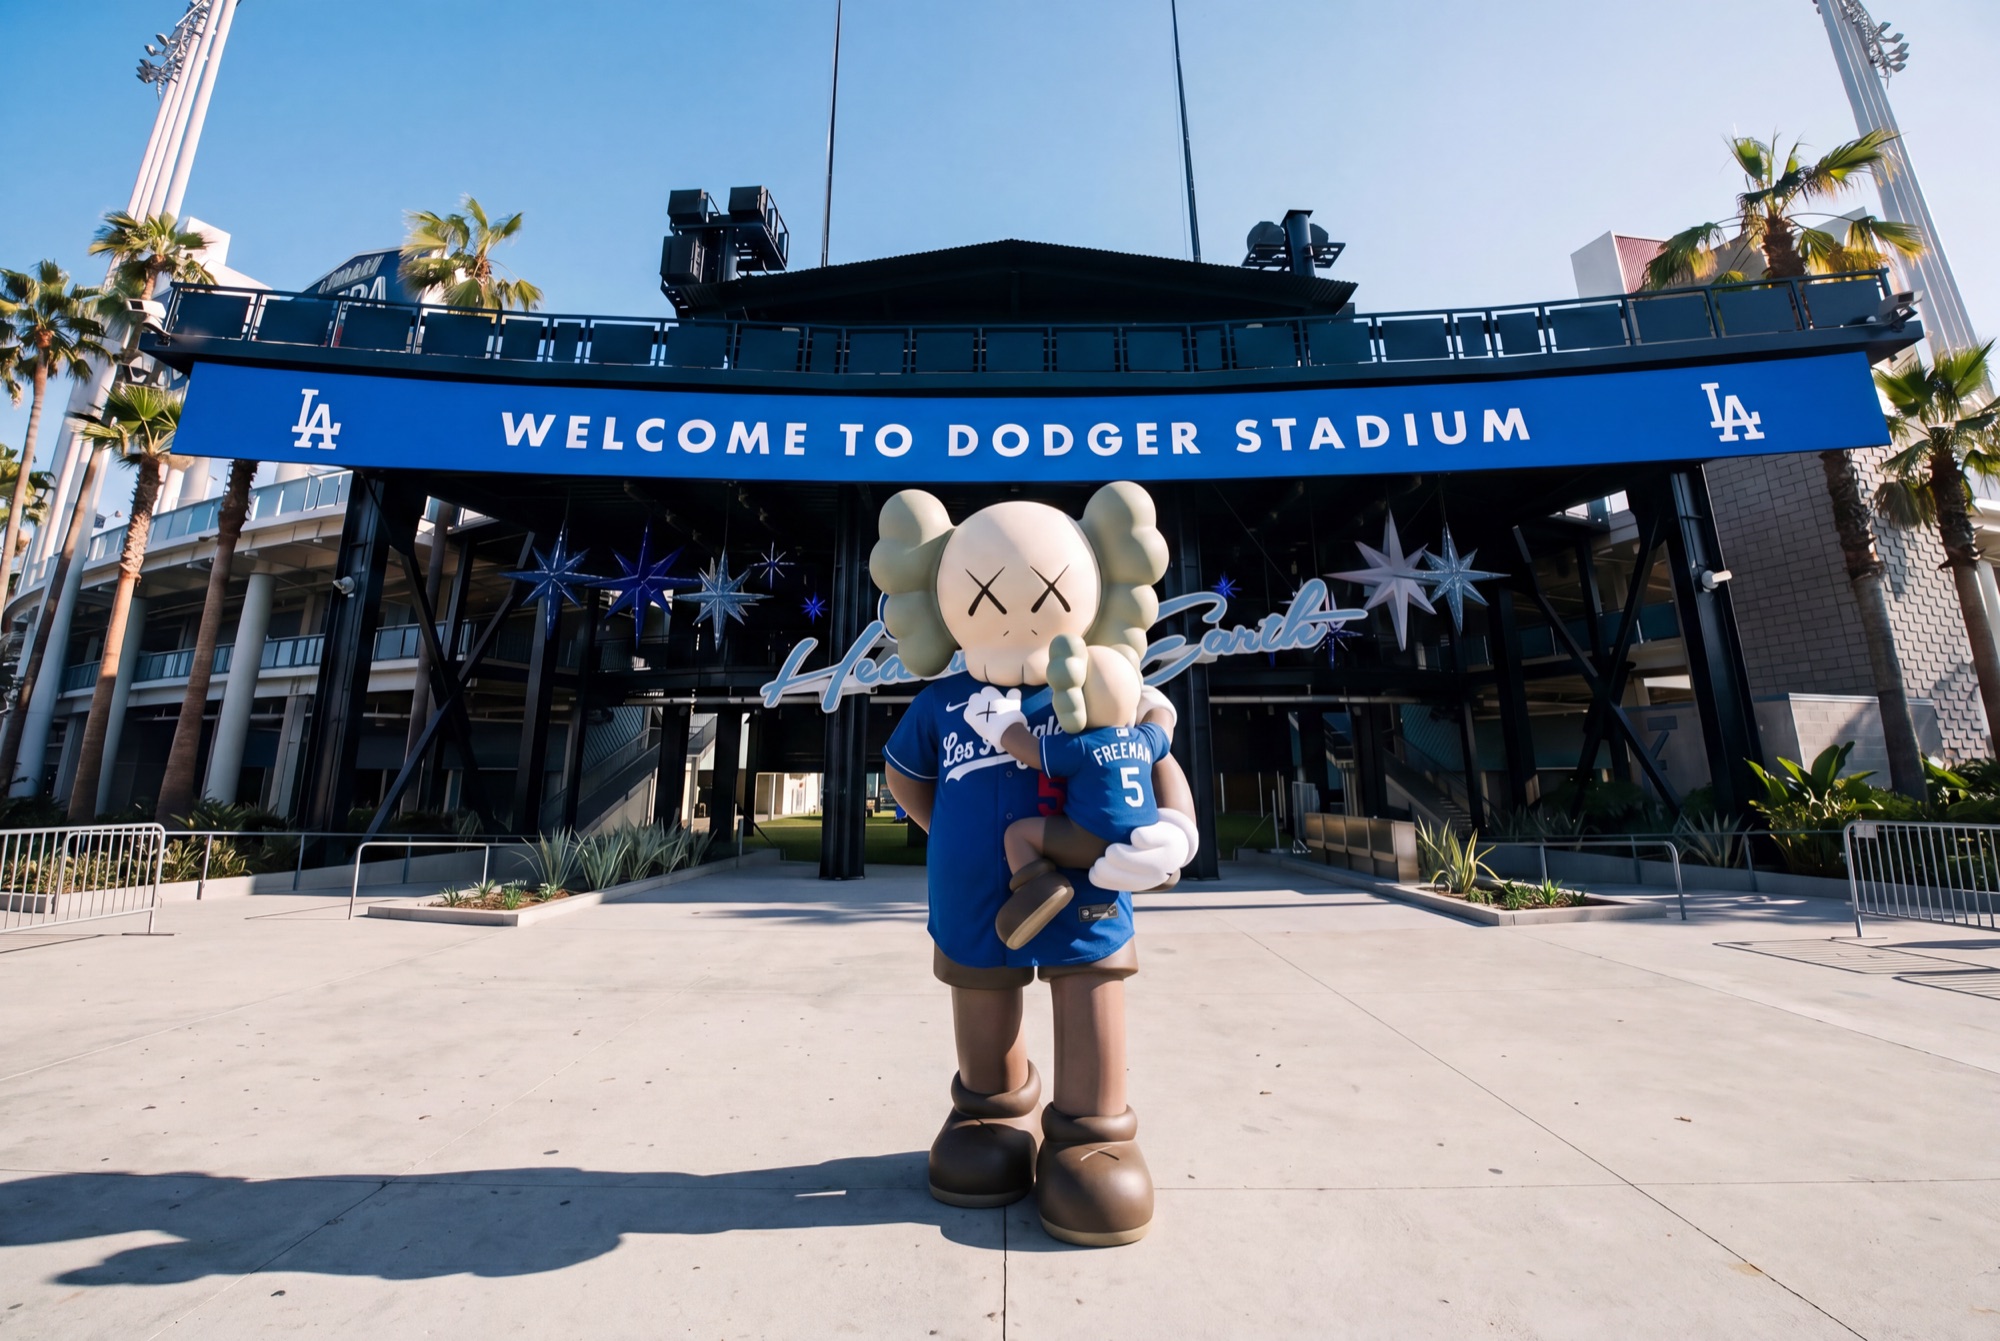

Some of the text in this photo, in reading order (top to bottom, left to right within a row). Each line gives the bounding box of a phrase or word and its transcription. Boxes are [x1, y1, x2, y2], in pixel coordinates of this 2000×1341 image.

[291, 388, 342, 450] LA
[502, 407, 1531, 458] WELCOME TO DODGER STADIUM
[1700, 382, 1765, 442] LA
[1140, 578, 1368, 687] Earth
[1093, 742, 1151, 766] FREEMAN
[1120, 767, 1144, 808] 5
